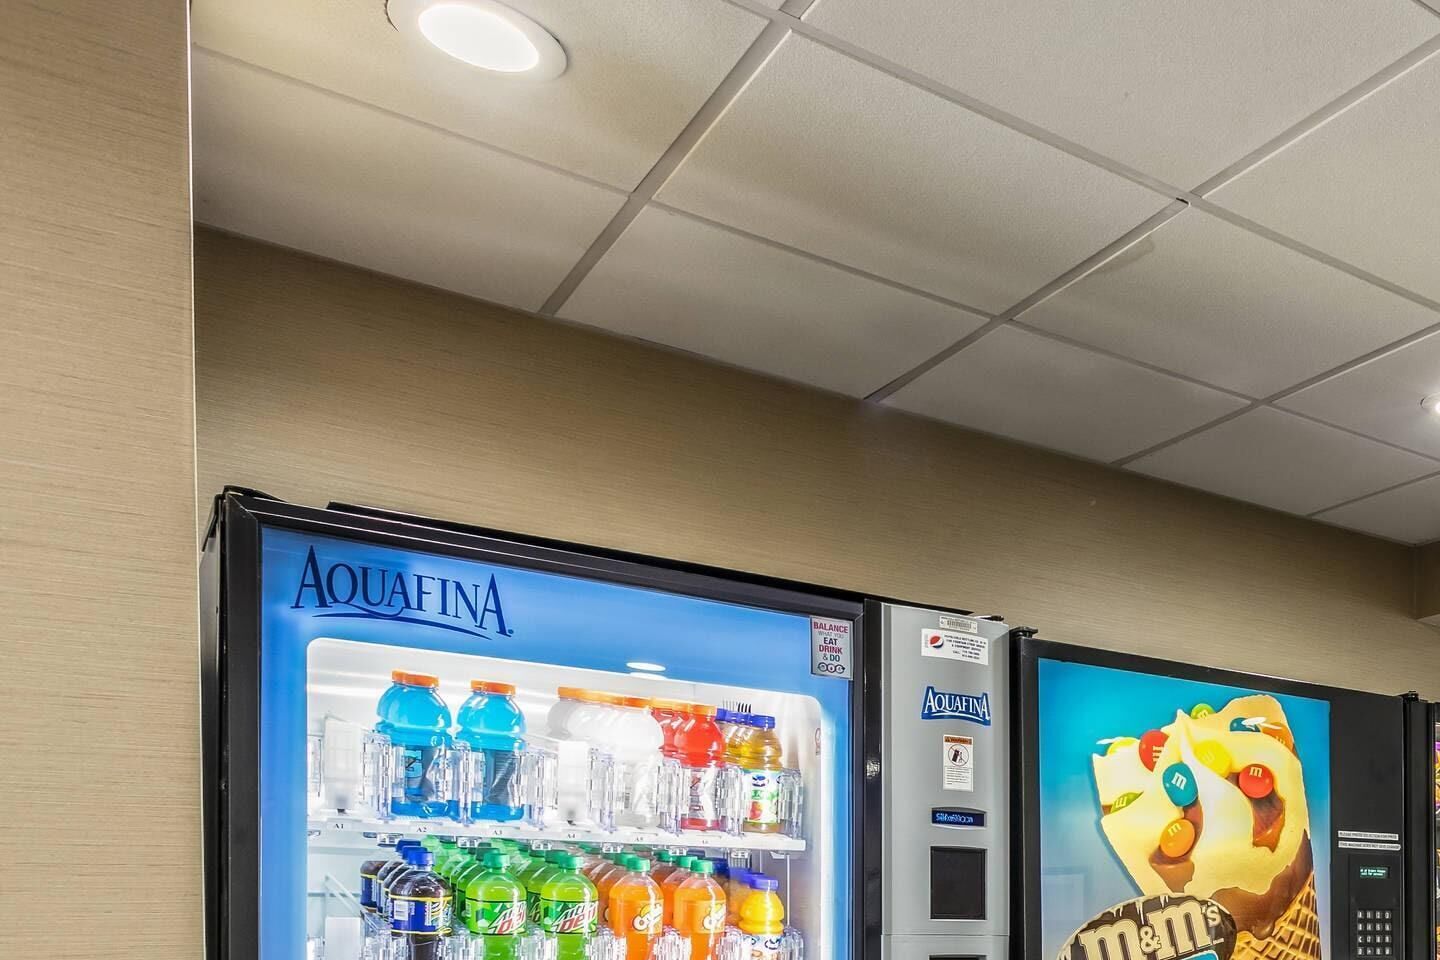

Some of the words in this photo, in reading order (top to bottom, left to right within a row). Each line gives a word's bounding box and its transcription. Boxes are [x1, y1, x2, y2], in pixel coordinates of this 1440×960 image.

[290, 545, 512, 638] AQUAFINA
[813, 621, 849, 634] BALANCE
[823, 637, 838, 646] EAT
[819, 645, 843, 655] DRINK
[923, 688, 991, 720] AQUAFINA
[1249, 765, 1263, 778] m
[1171, 772, 1187, 790] m
[1168, 823, 1181, 836] m
